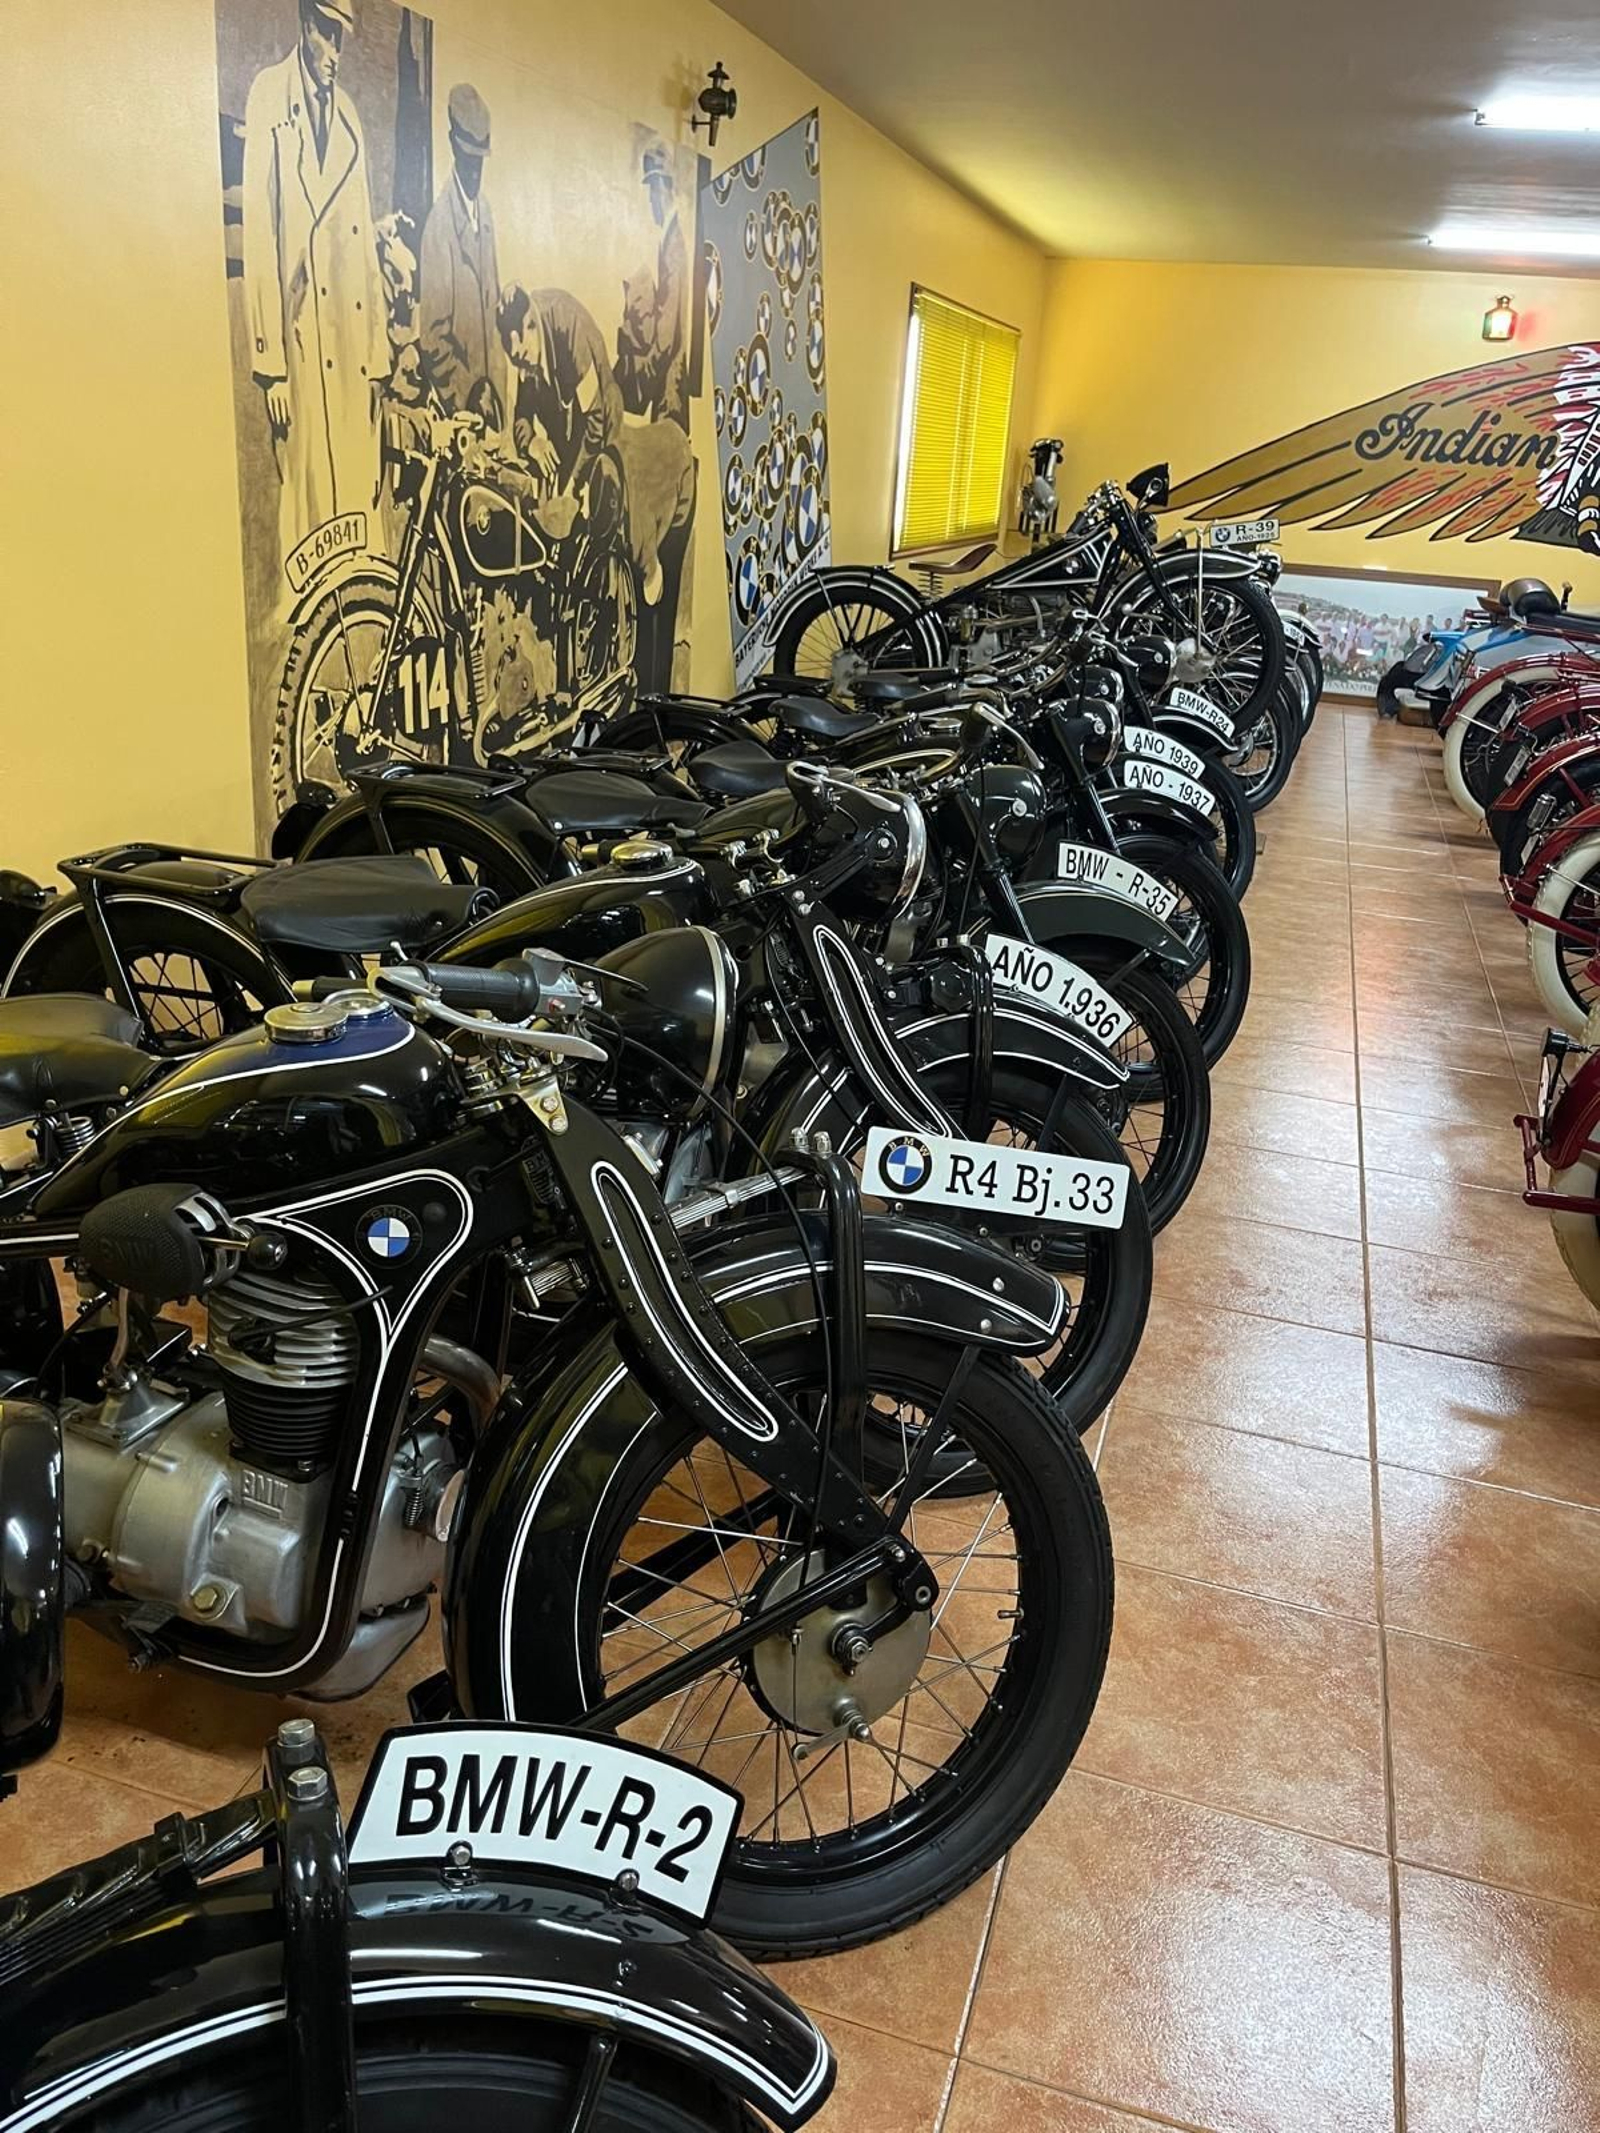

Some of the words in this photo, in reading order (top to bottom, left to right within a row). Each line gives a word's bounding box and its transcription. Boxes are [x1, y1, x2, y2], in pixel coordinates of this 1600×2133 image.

[1355, 401, 1559, 470] Indian
[296, 518, 359, 576] B-69841
[398, 646, 450, 734] 114
[1176, 691, 1230, 733] BMW-R24
[1132, 731, 1165, 755] AÑO
[1169, 746, 1199, 776] 1939
[1129, 765, 1165, 789] AÑO
[1177, 781, 1211, 811] 1937
[1066, 848, 1110, 881] BMW
[1128, 872, 1171, 916] R-35
[992, 945, 1054, 993] AÑO
[1058, 976, 1121, 1040] 1.936
[887, 1136, 931, 1157] BMW
[371, 1207, 412, 1221] BMW
[945, 1153, 998, 1199] R4
[1012, 1163, 1115, 1216] Bj.33
[395, 1753, 714, 1884] BMW-R-2
